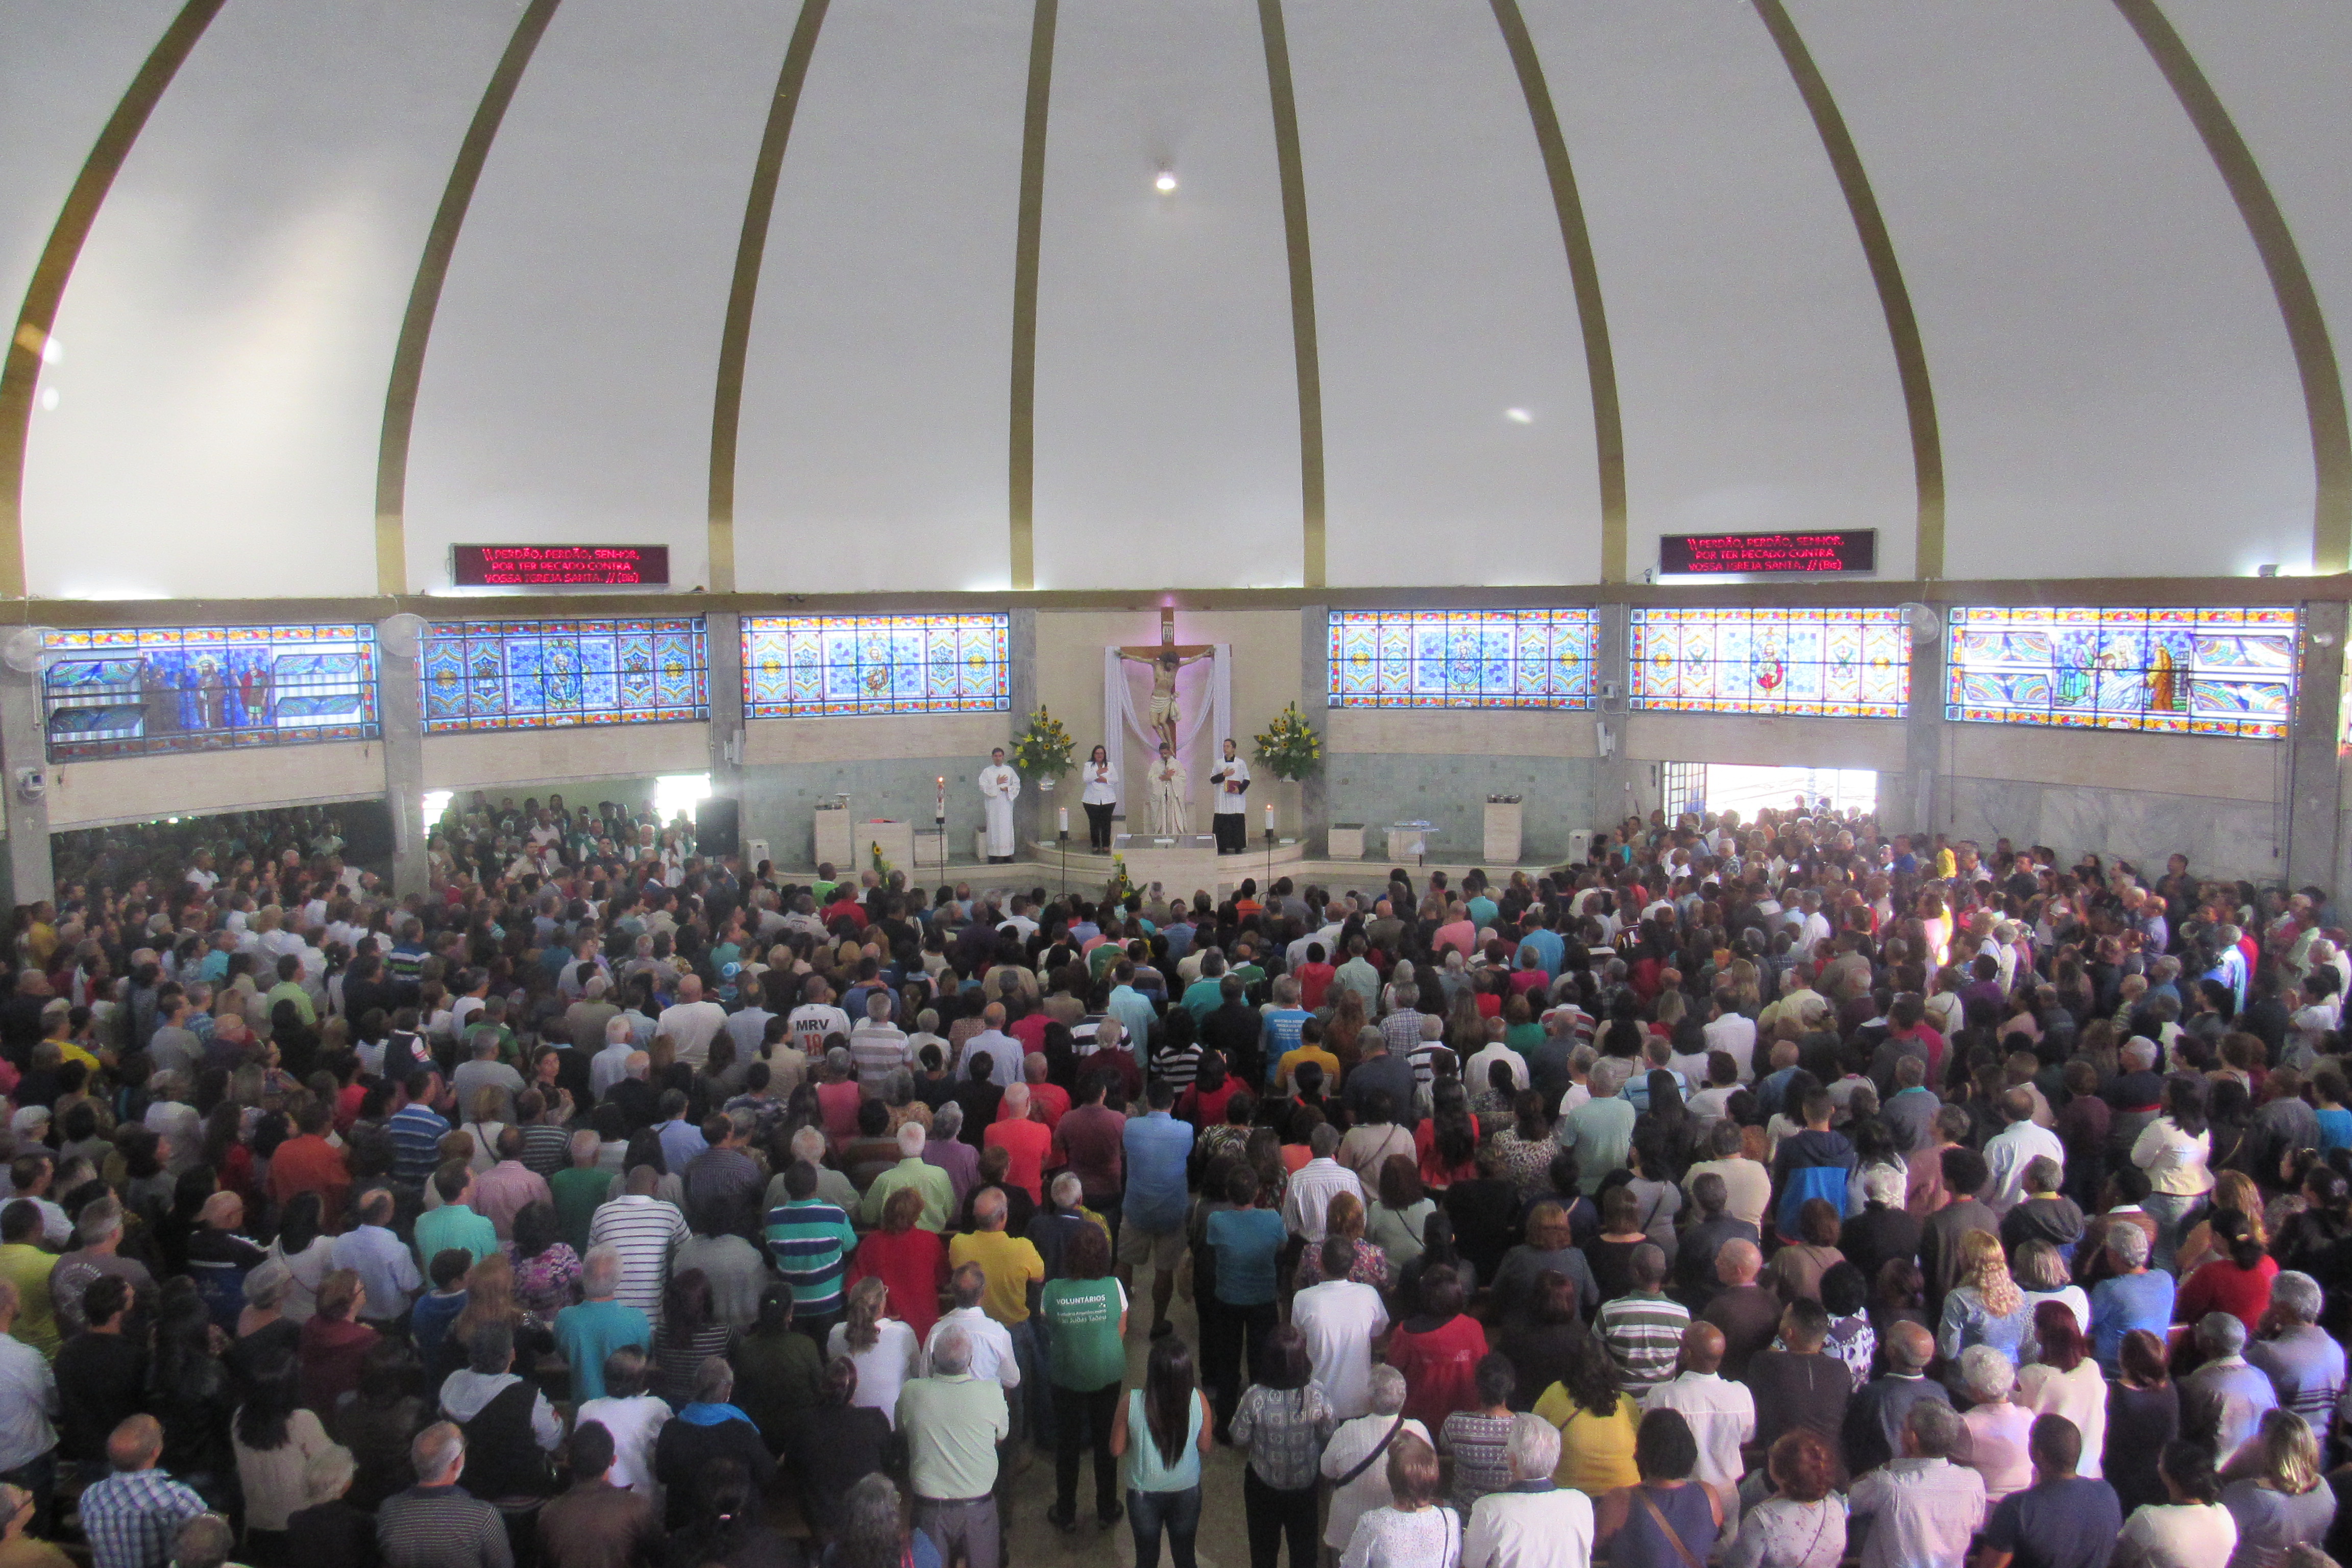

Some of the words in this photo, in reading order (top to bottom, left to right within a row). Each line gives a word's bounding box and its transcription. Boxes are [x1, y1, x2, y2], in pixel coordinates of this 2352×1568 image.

[1699, 536, 1745, 548] PERDÃO,
[1747, 535, 1794, 547] PERDÃO,
[1796, 536, 1844, 546] SENHOR,
[495, 547, 543, 559] PERDÃO,
[545, 547, 593, 559] PERDÃO,
[594, 550, 641, 560] SENHOR,
[1695, 551, 1717, 559] POR
[1721, 550, 1738, 559] TER
[1741, 549, 1785, 558] PECADO
[1788, 548, 1834, 558] CONTRA
[492, 562, 514, 570] POR
[519, 562, 537, 570] TER
[540, 562, 585, 570] PECADO
[587, 562, 633, 570] CONTRA
[1688, 562, 1723, 571] VOSSA
[1726, 561, 1762, 571] IGREJA
[484, 574, 522, 582] VOSSA
[525, 574, 562, 582] IGREJA
[796, 1019, 829, 1031] MRV
[1056, 1294, 1106, 1305] VOLUNTÁRIOS
